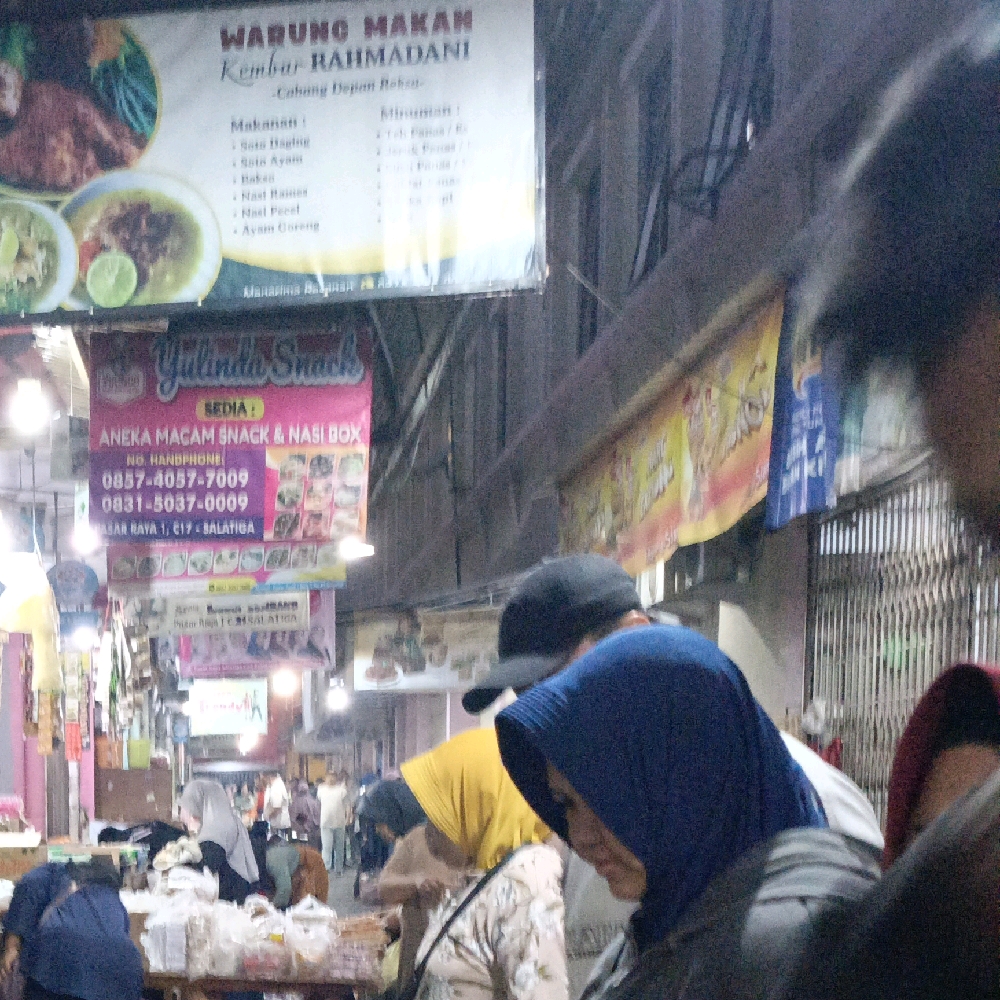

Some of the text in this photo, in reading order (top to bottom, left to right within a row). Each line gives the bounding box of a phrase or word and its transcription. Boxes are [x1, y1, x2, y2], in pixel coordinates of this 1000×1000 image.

[219, 10, 473, 49] WARUNG MAKAN
[311, 40, 471, 73] RAHMADANI
[231, 116, 298, 133] Makanan
[99, 422, 362, 447] ANEKA MACAM SNACK & NASI BOX
